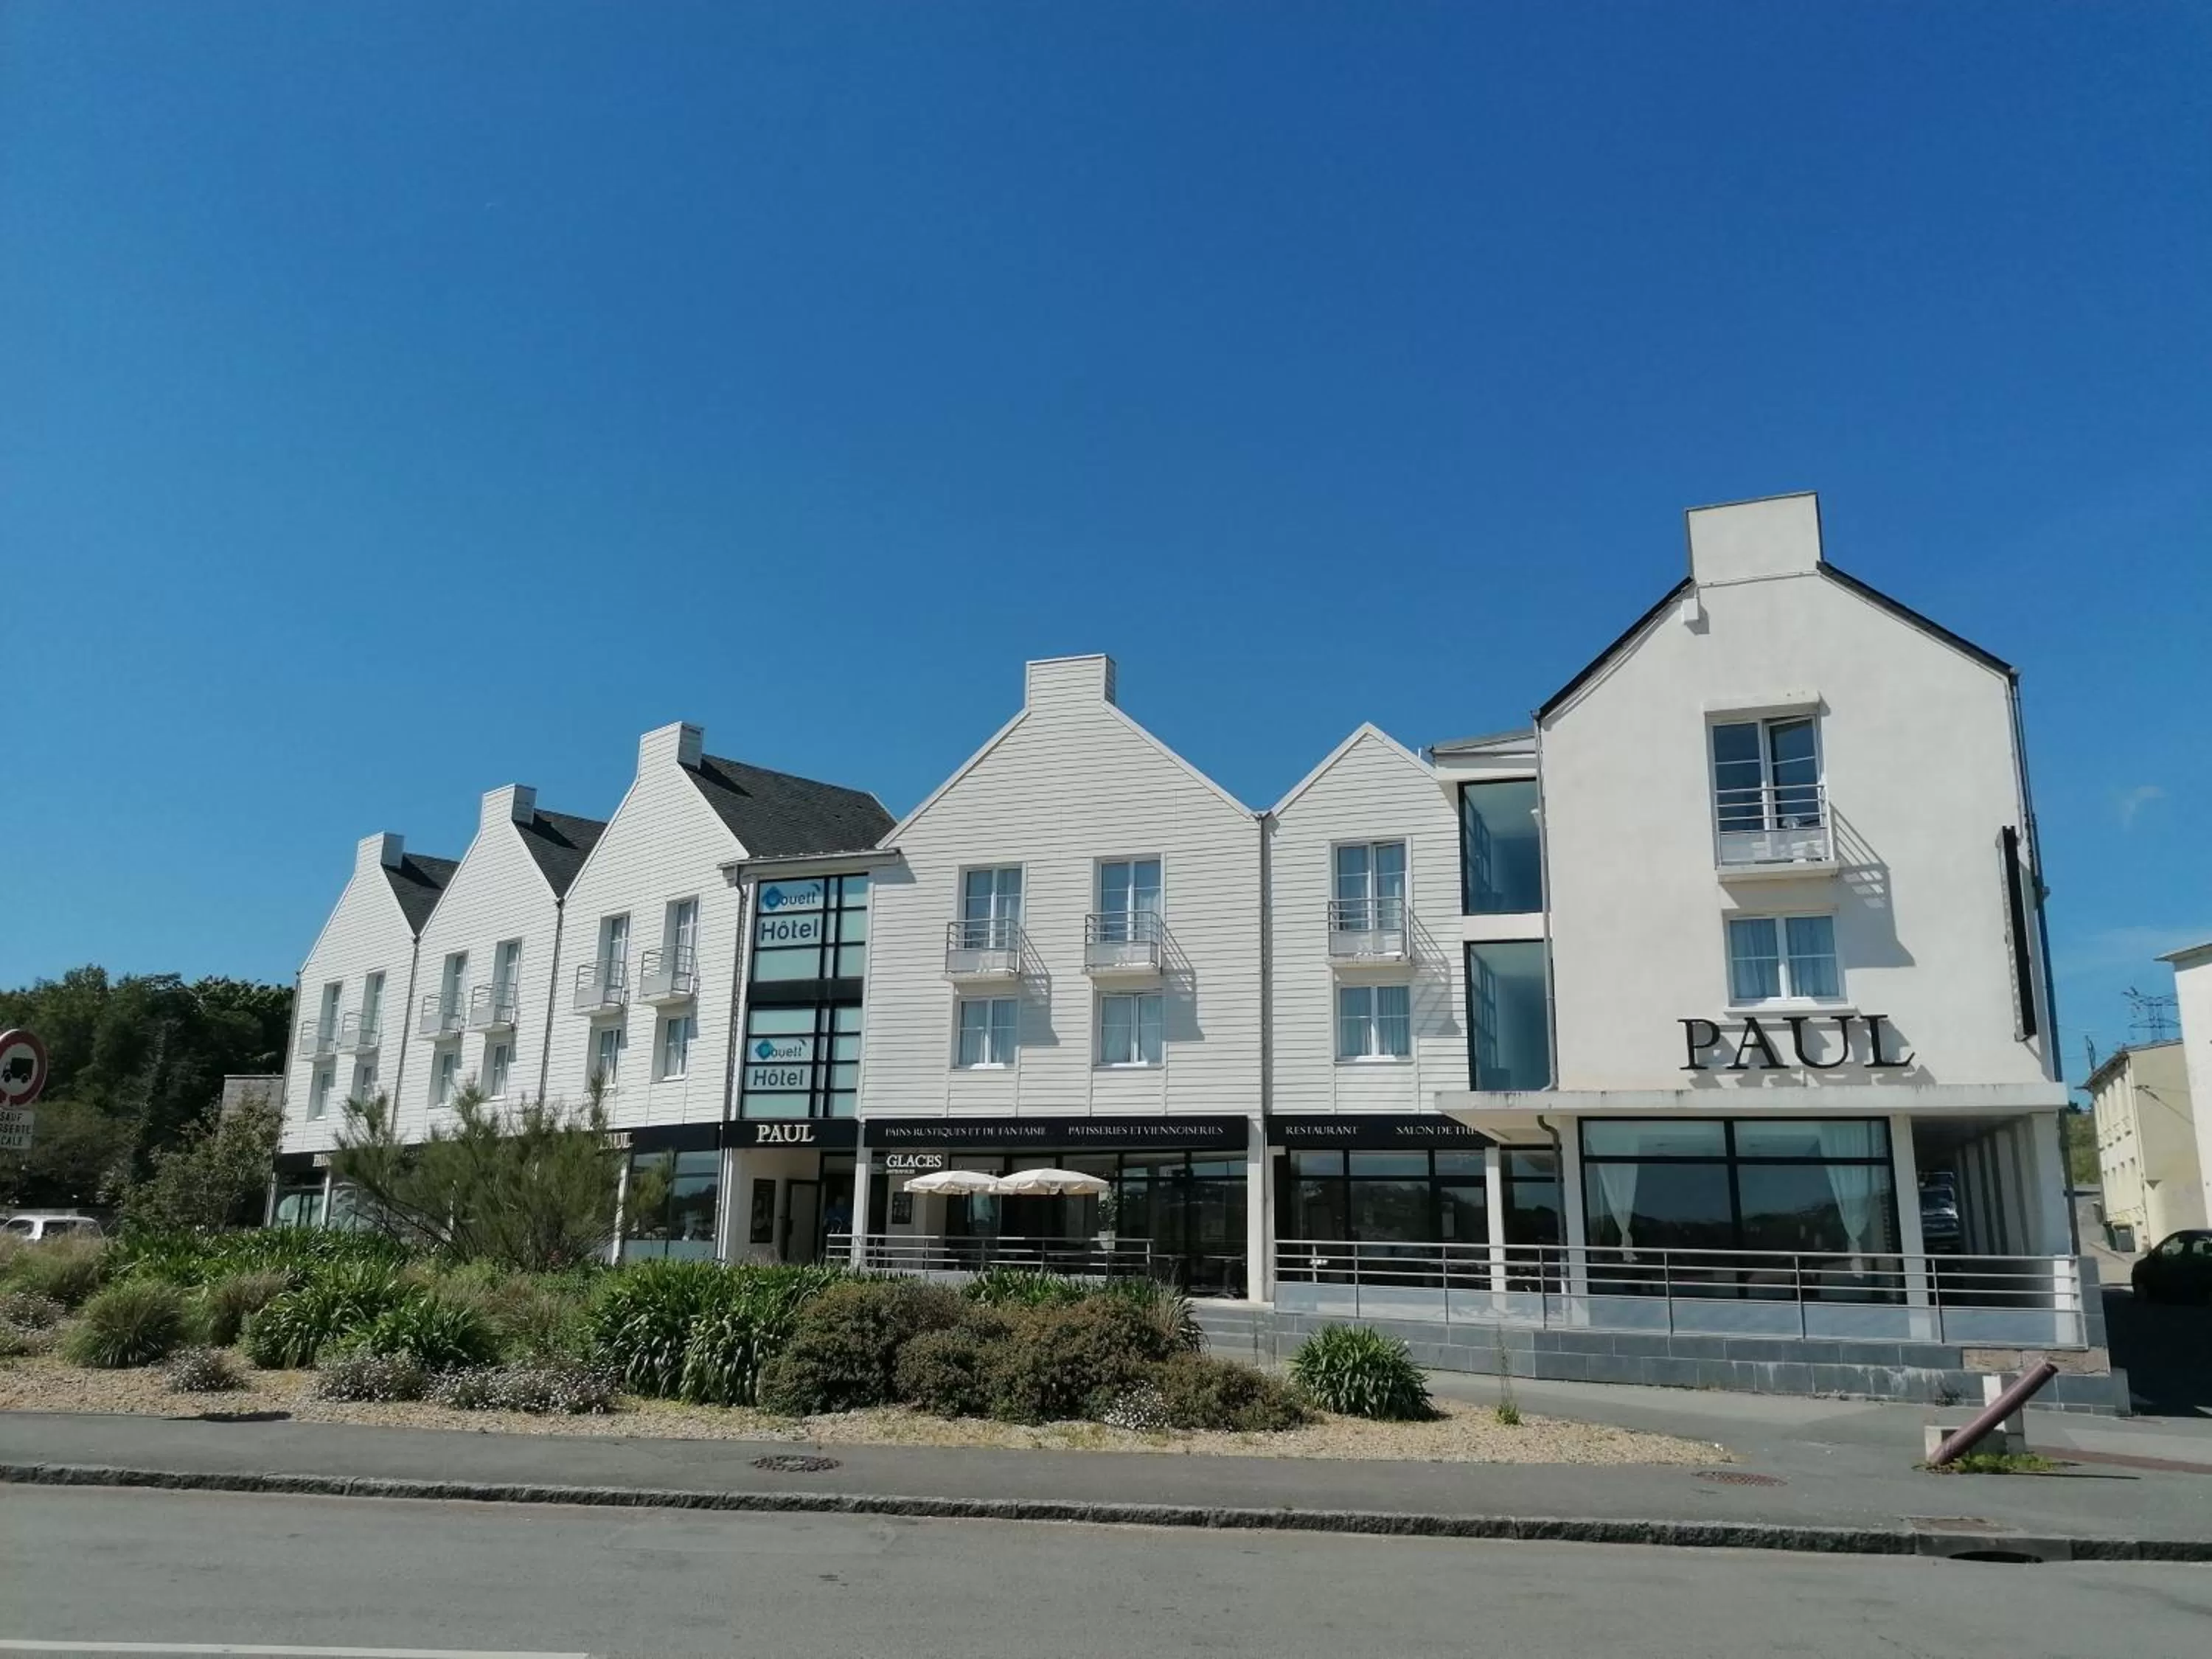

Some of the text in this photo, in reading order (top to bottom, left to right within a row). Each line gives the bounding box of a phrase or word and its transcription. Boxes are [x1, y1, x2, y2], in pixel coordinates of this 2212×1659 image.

[761, 919, 818, 940] Hôtel
[1677, 1014, 1916, 1070] PAUL
[753, 1069, 804, 1085] Hôtel
[756, 1124, 815, 1143] PAUL
[1285, 1126, 1358, 1135] RESTAURANT
[1396, 1126, 1434, 1135] SALON
[1436, 1126, 1453, 1135] DE
[599, 1132, 634, 1150] AUL
[886, 1154, 942, 1168] GLACES
